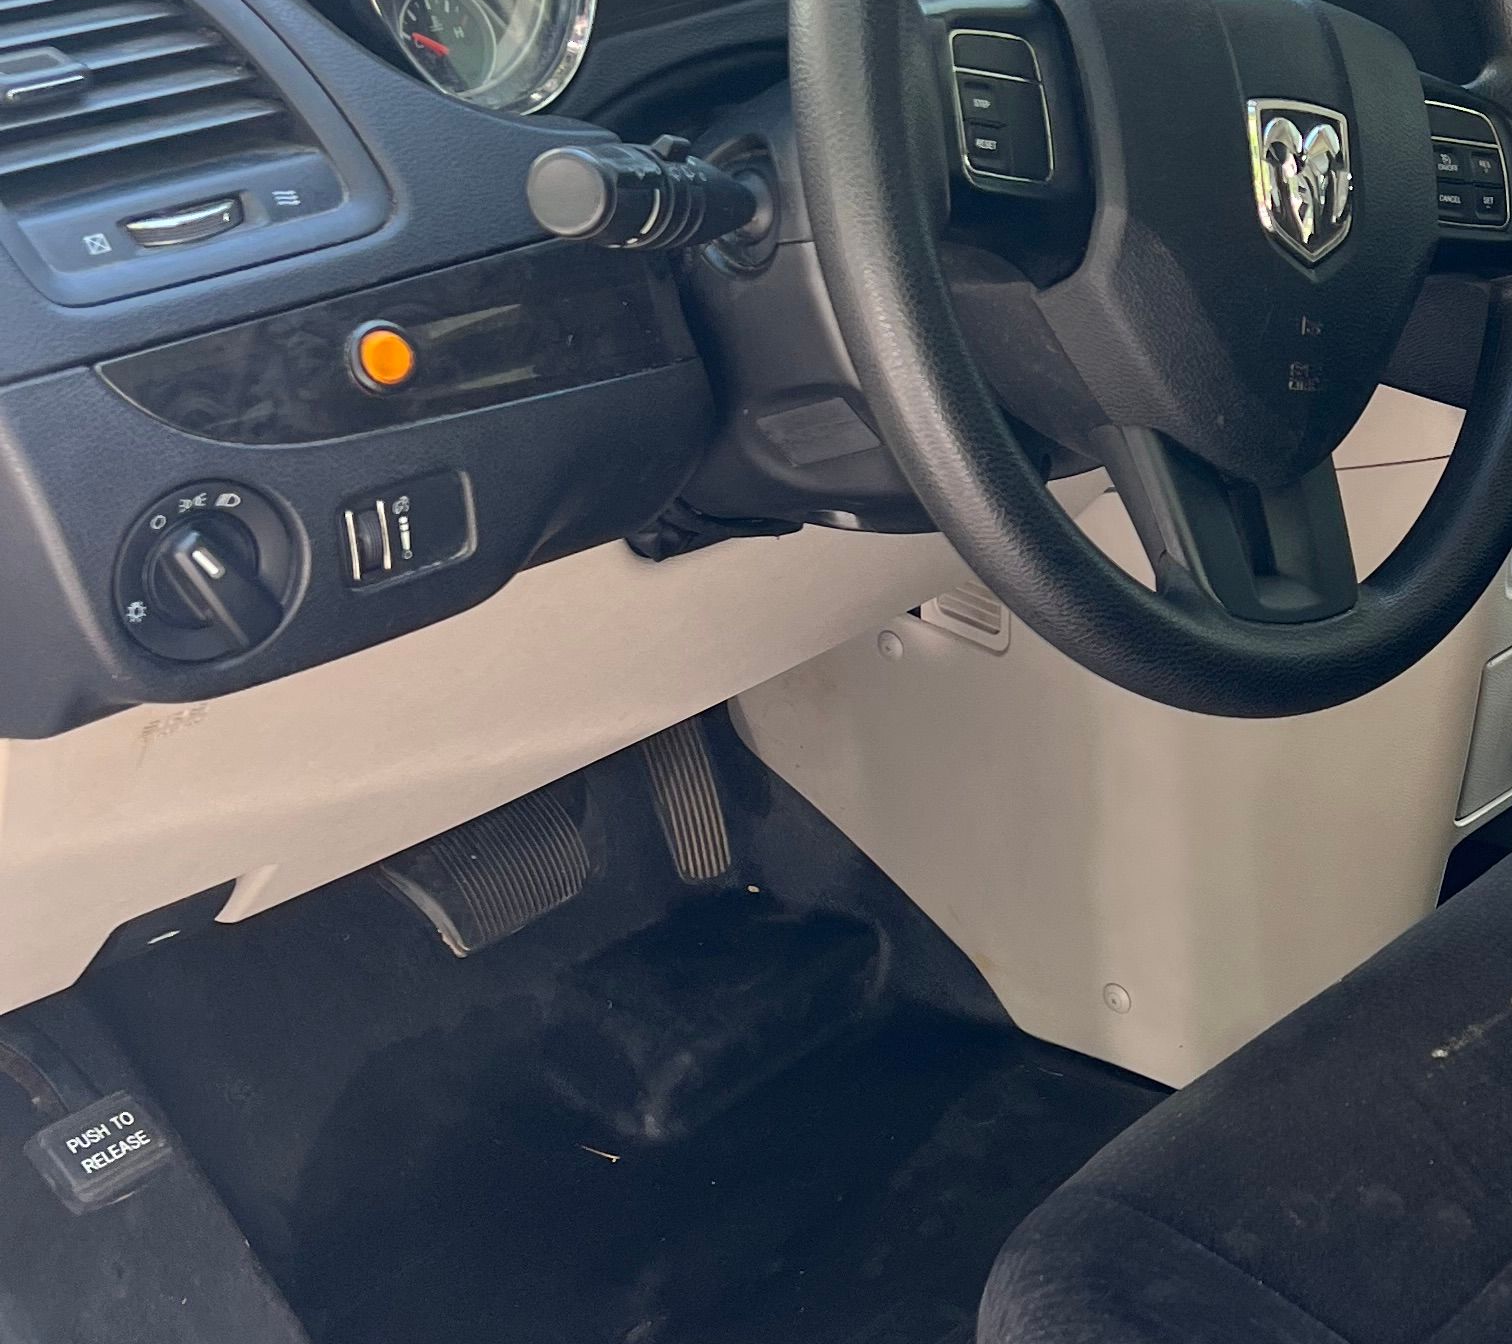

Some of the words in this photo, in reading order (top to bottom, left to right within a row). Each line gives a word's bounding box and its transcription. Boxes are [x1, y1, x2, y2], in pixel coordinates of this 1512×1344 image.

[66, 1123, 111, 1154] PUSH
[110, 1111, 135, 1130] TO
[80, 1129, 151, 1174] RELEASE
